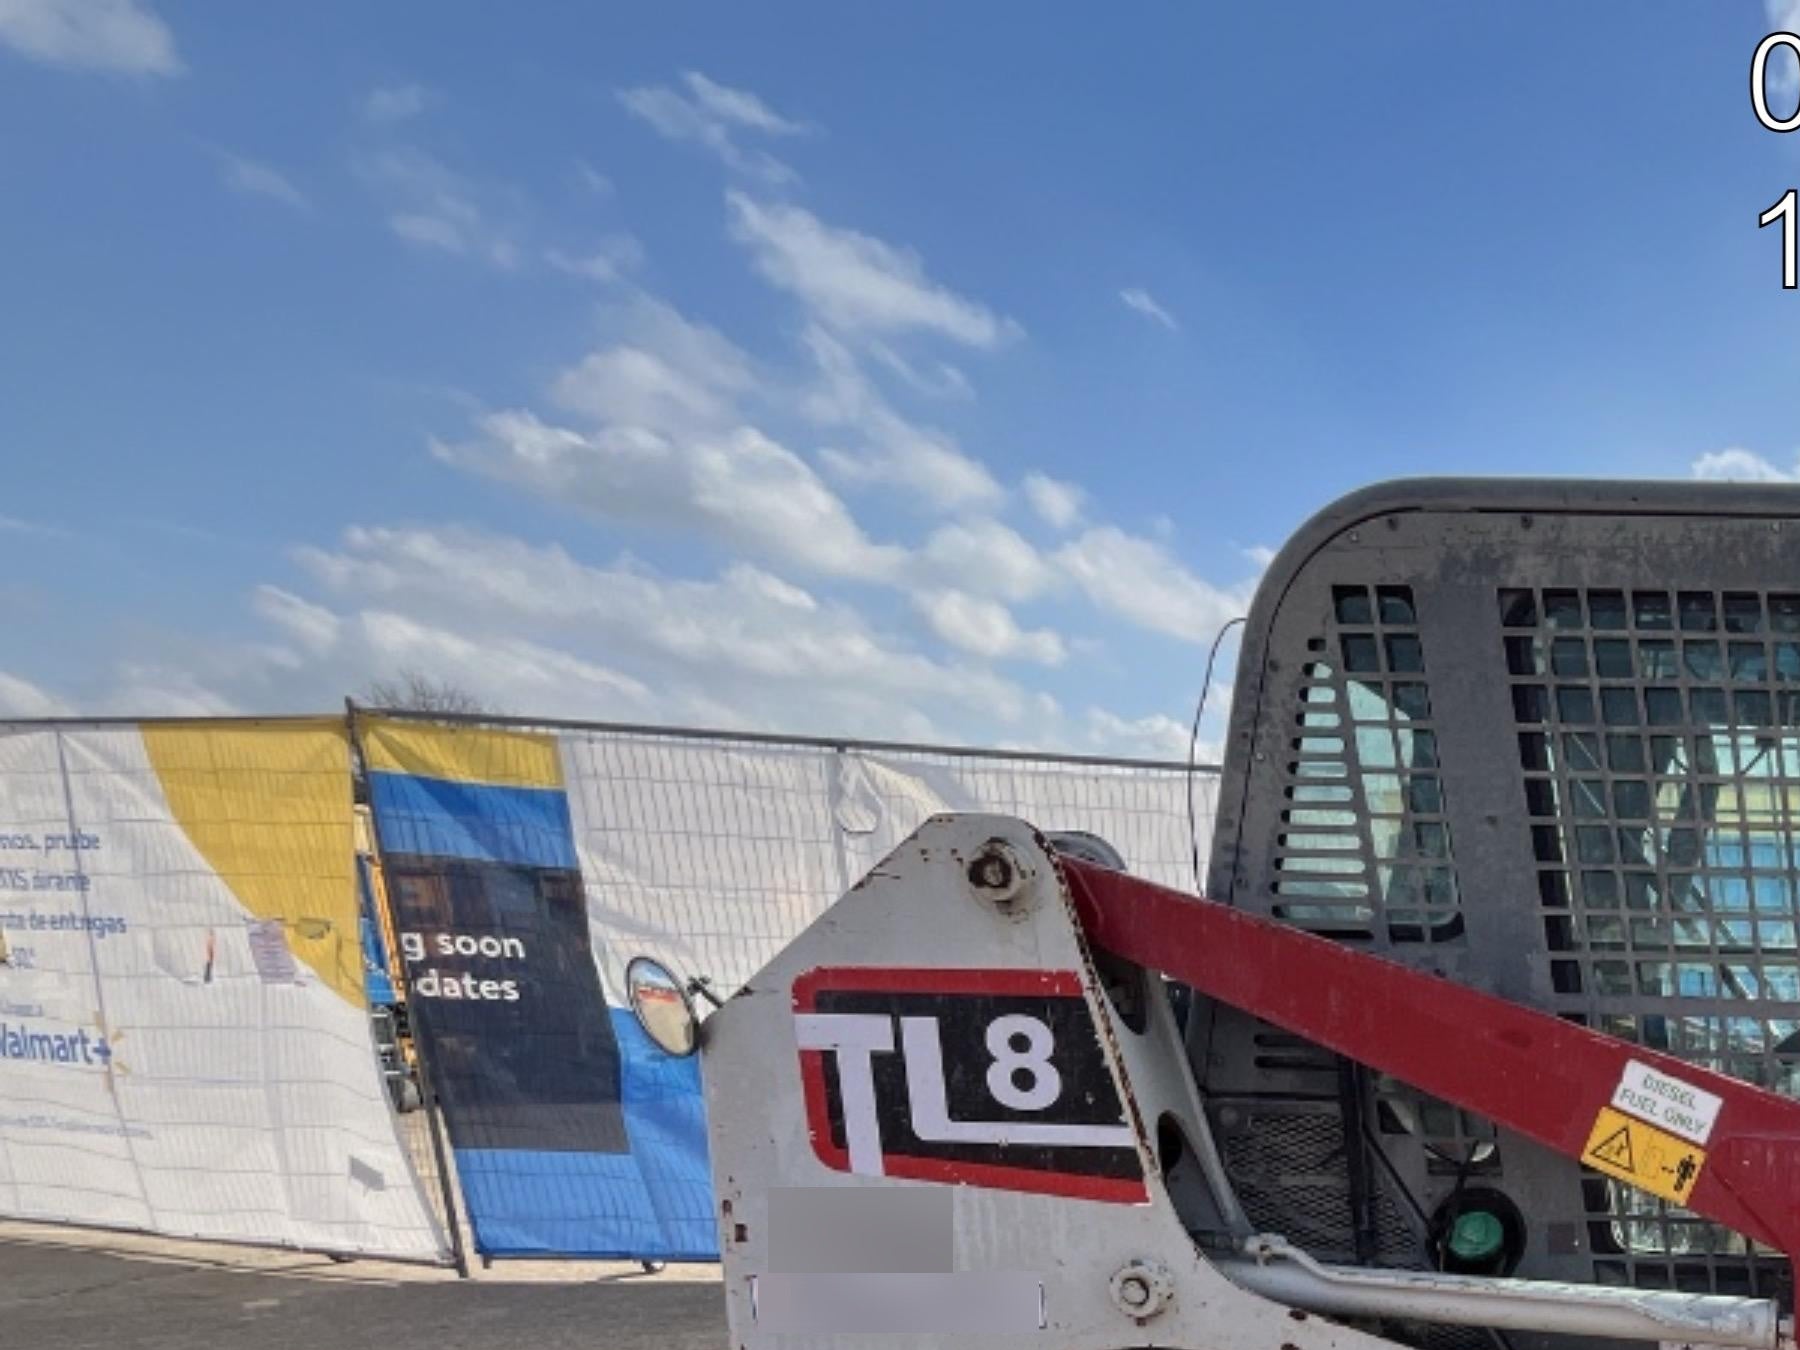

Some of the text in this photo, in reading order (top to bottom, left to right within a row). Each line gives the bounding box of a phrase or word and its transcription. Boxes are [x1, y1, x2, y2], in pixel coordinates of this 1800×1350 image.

[434, 932, 526, 959] soon
[411, 967, 521, 1001] dates
[1642, 1073, 1697, 1111] DIESEL
[1619, 1087, 1706, 1135] FUEL ONLY
